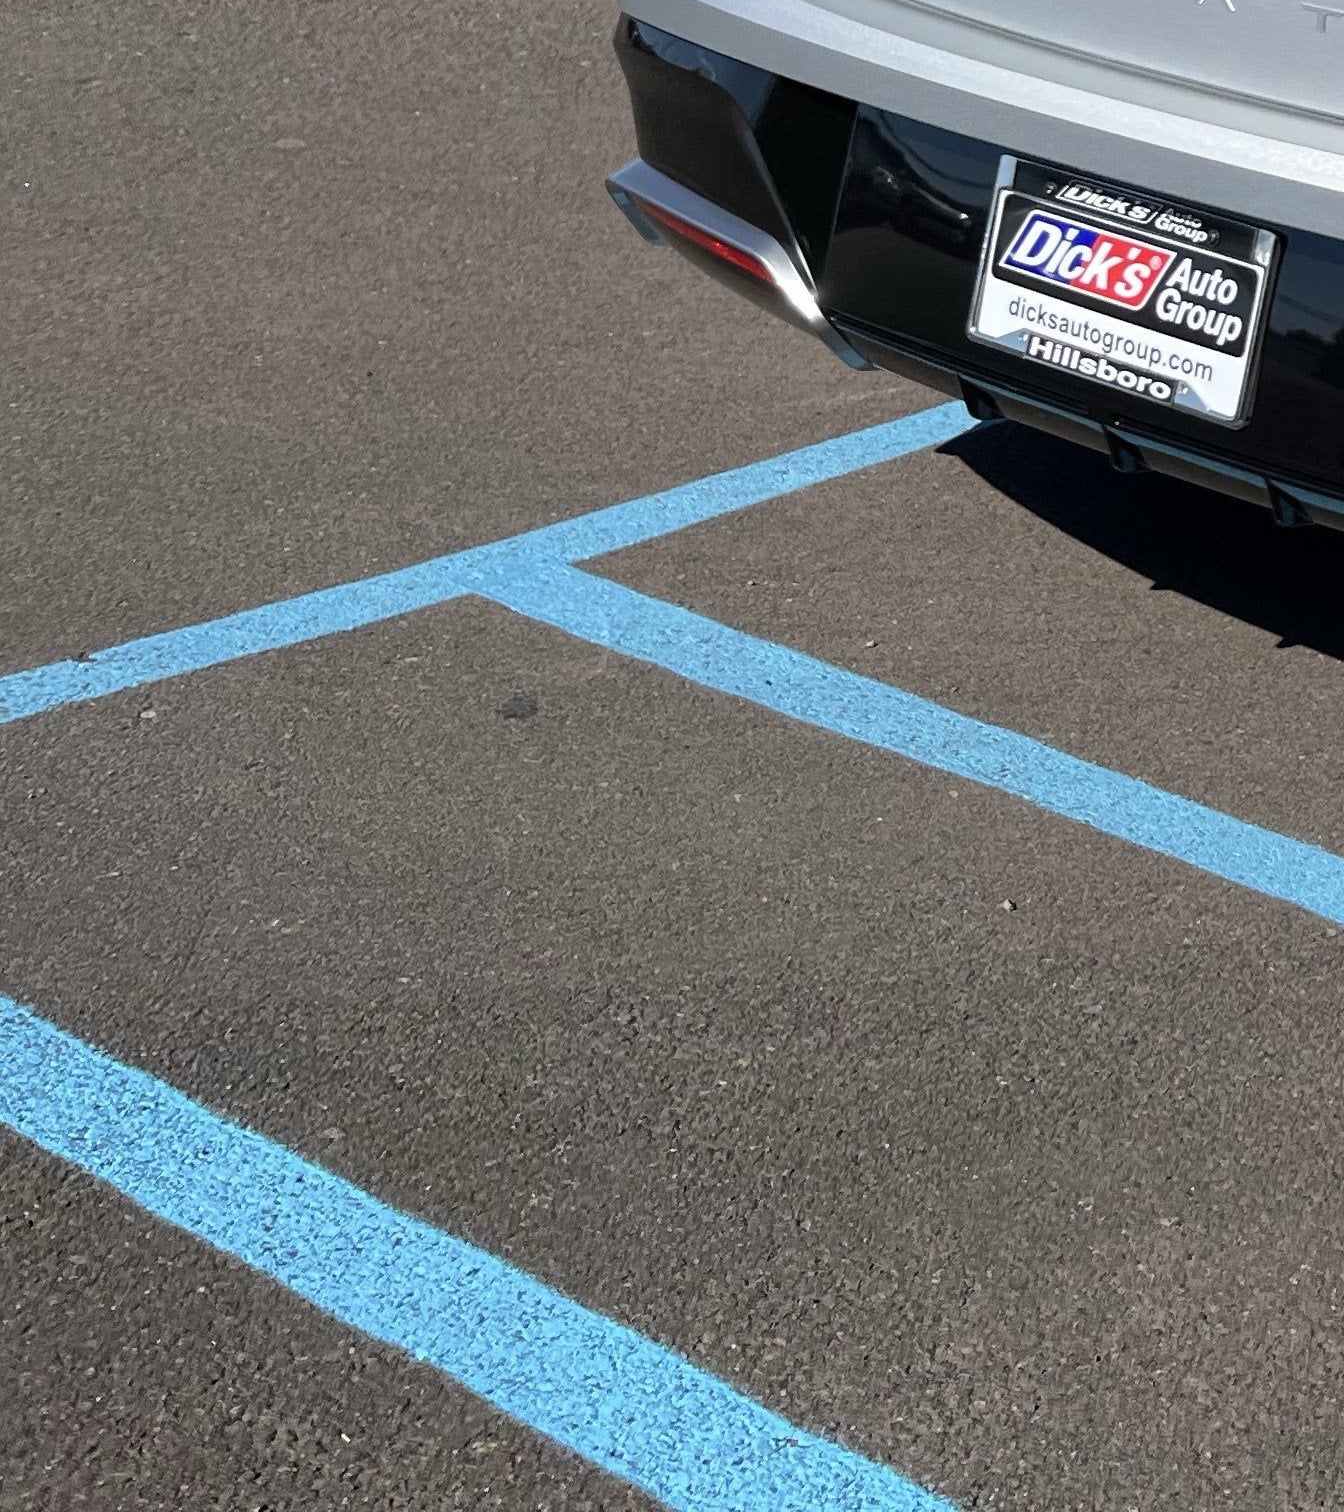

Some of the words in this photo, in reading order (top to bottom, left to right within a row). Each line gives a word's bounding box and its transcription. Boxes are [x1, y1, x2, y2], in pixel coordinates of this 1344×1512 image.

[1011, 219, 1151, 298] Dick's
[1155, 214, 1208, 243] Group
[1165, 257, 1238, 305] Auto
[1008, 296, 1213, 382] dicksautogroup.com
[1155, 287, 1242, 345] Group
[1028, 336, 1171, 399] Hillsboro
